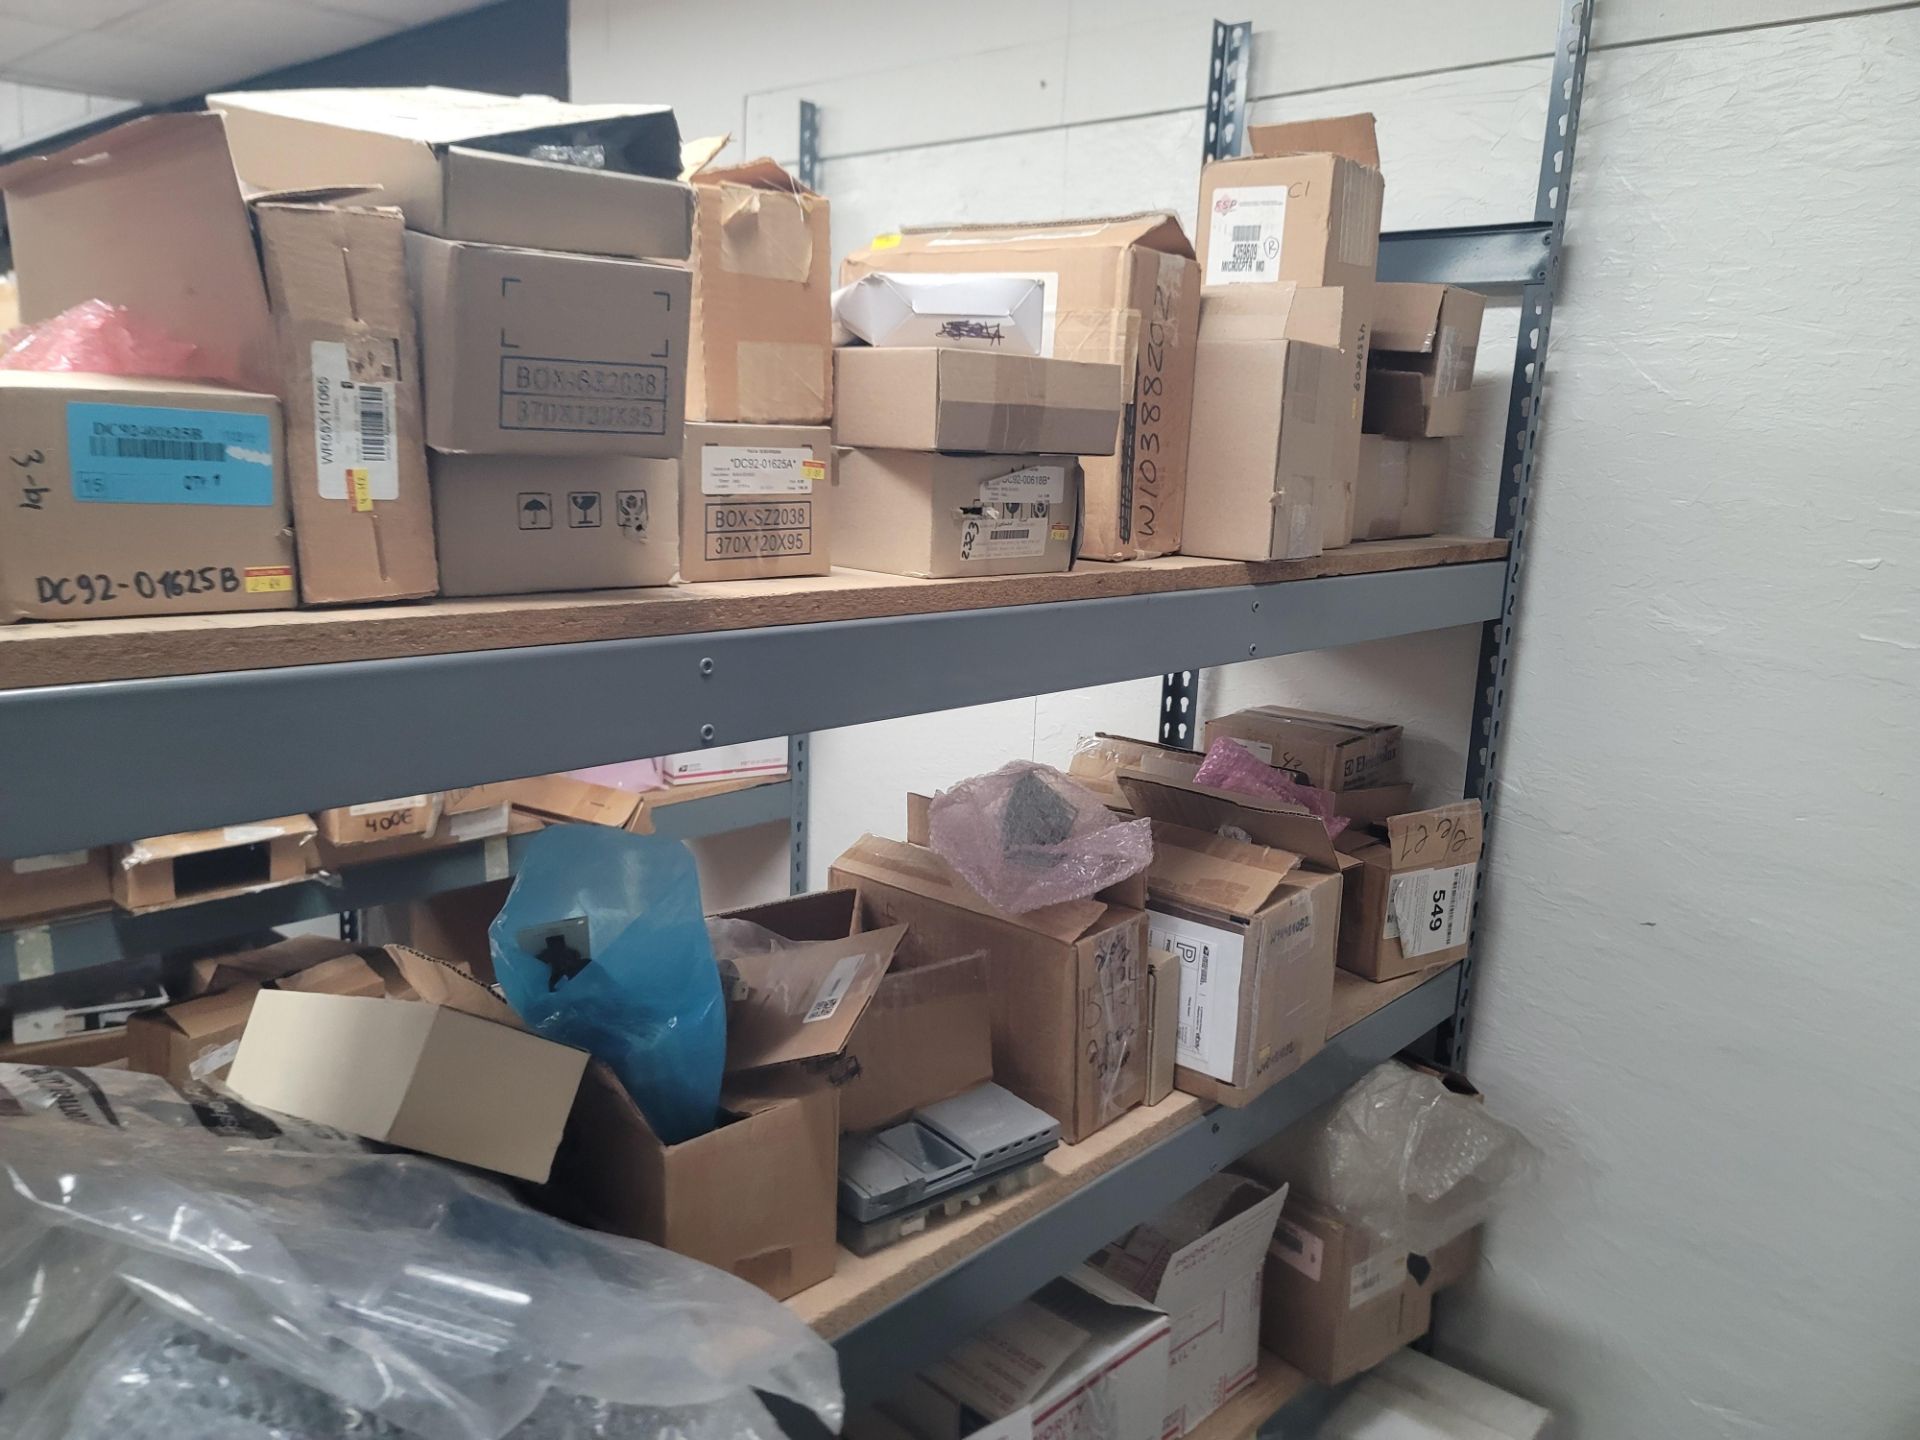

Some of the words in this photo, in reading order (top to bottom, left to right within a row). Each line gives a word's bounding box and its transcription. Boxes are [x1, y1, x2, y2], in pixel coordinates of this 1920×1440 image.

[715, 508, 805, 528] BOX-SZ2038
[715, 533, 804, 555] 370X120X95
[1429, 889, 1446, 931] 549
